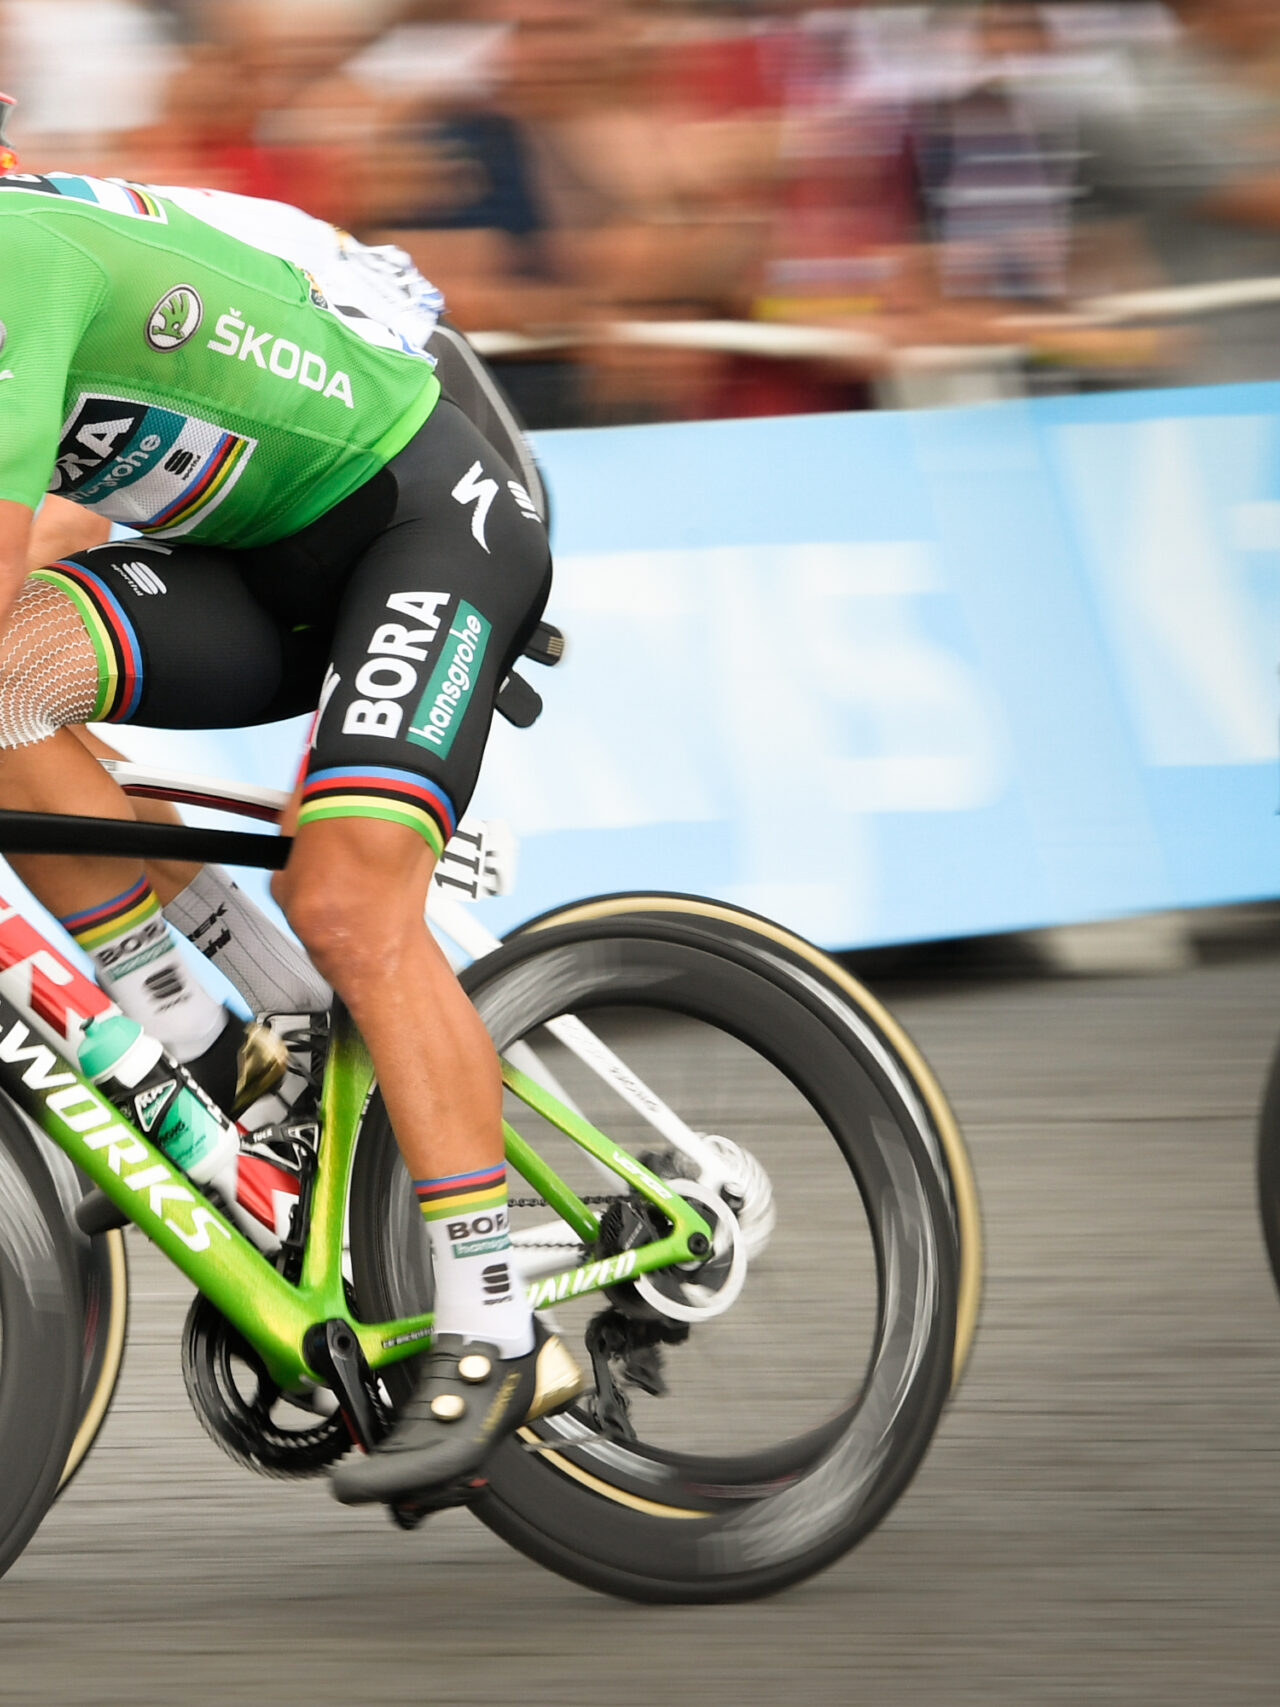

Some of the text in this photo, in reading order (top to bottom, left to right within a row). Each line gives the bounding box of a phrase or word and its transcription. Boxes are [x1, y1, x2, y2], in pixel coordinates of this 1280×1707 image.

[207, 307, 354, 409] ŠKODA
[111, 563, 144, 597] sportful
[342, 591, 451, 739] BORA
[408, 614, 482, 746] hansgrohe
[434, 830, 483, 899] 111
[187, 902, 228, 942] EK
[447, 1213, 508, 1240] BOR
